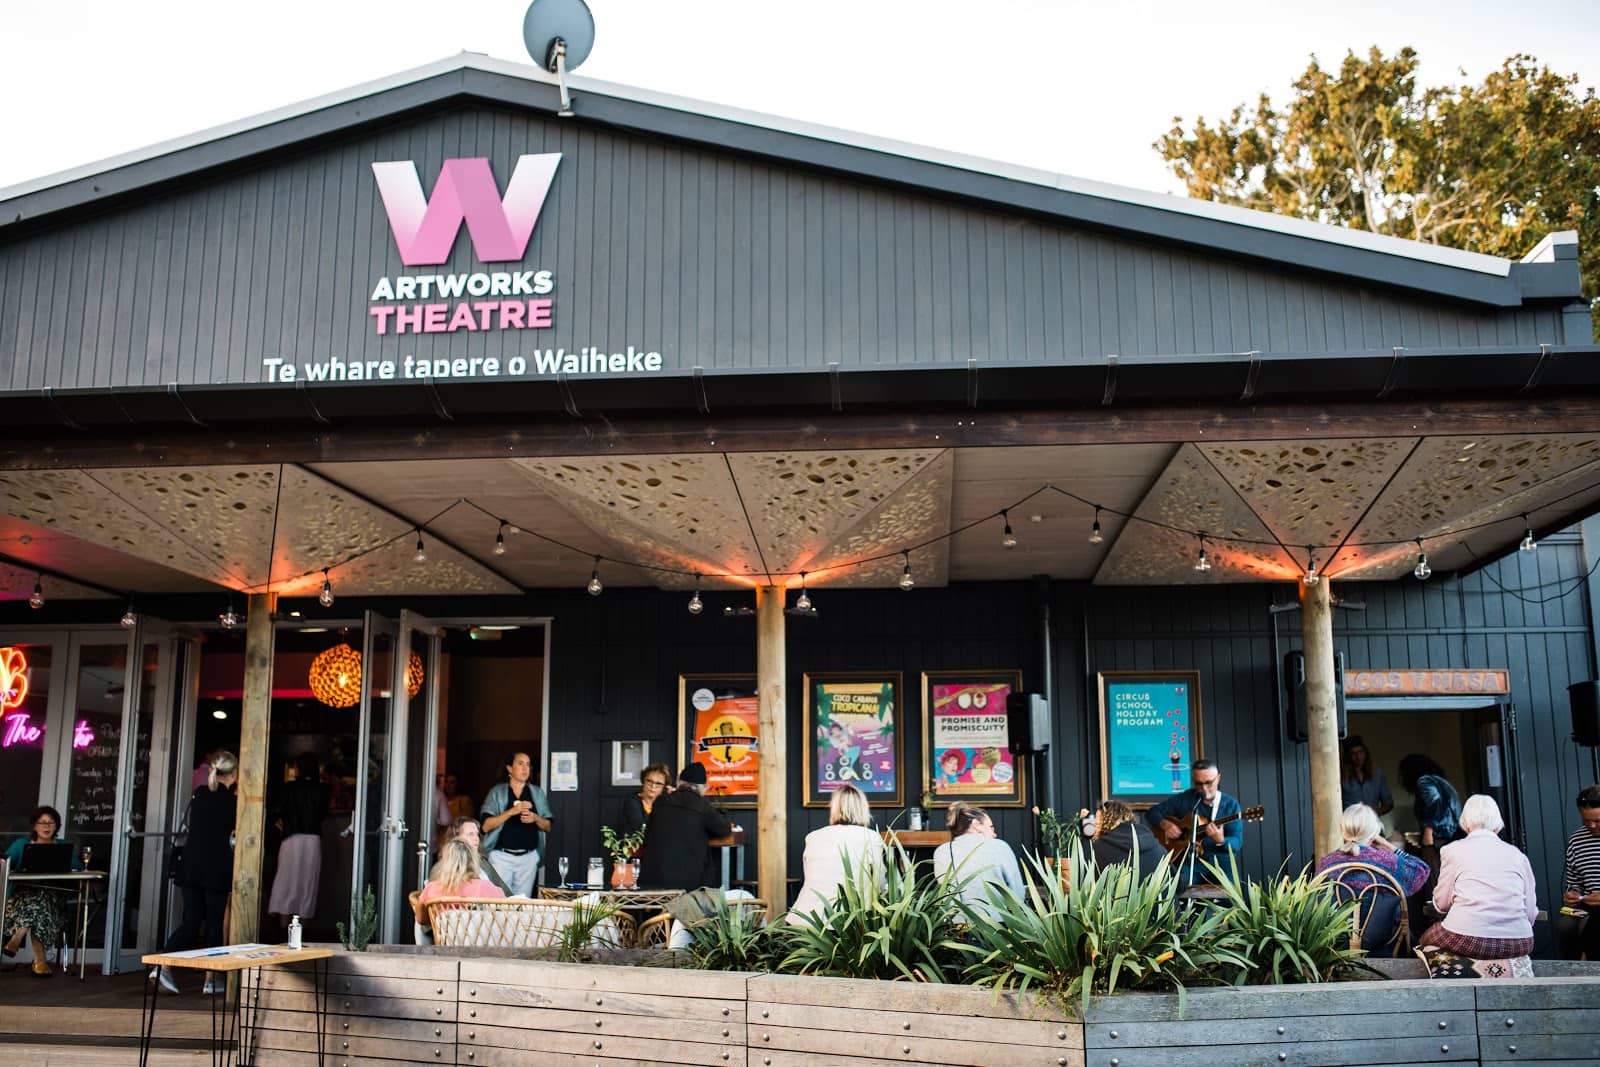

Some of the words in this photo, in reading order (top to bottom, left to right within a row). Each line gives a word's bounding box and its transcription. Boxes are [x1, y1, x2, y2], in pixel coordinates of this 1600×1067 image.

[371, 270, 553, 301] ARTWORKS
[370, 299, 552, 335] THEATRE
[263, 357, 296, 382] Te
[304, 356, 396, 382] whare
[508, 356, 526, 376] o
[534, 346, 662, 375] Waiheke
[4, 713, 41, 747] The
